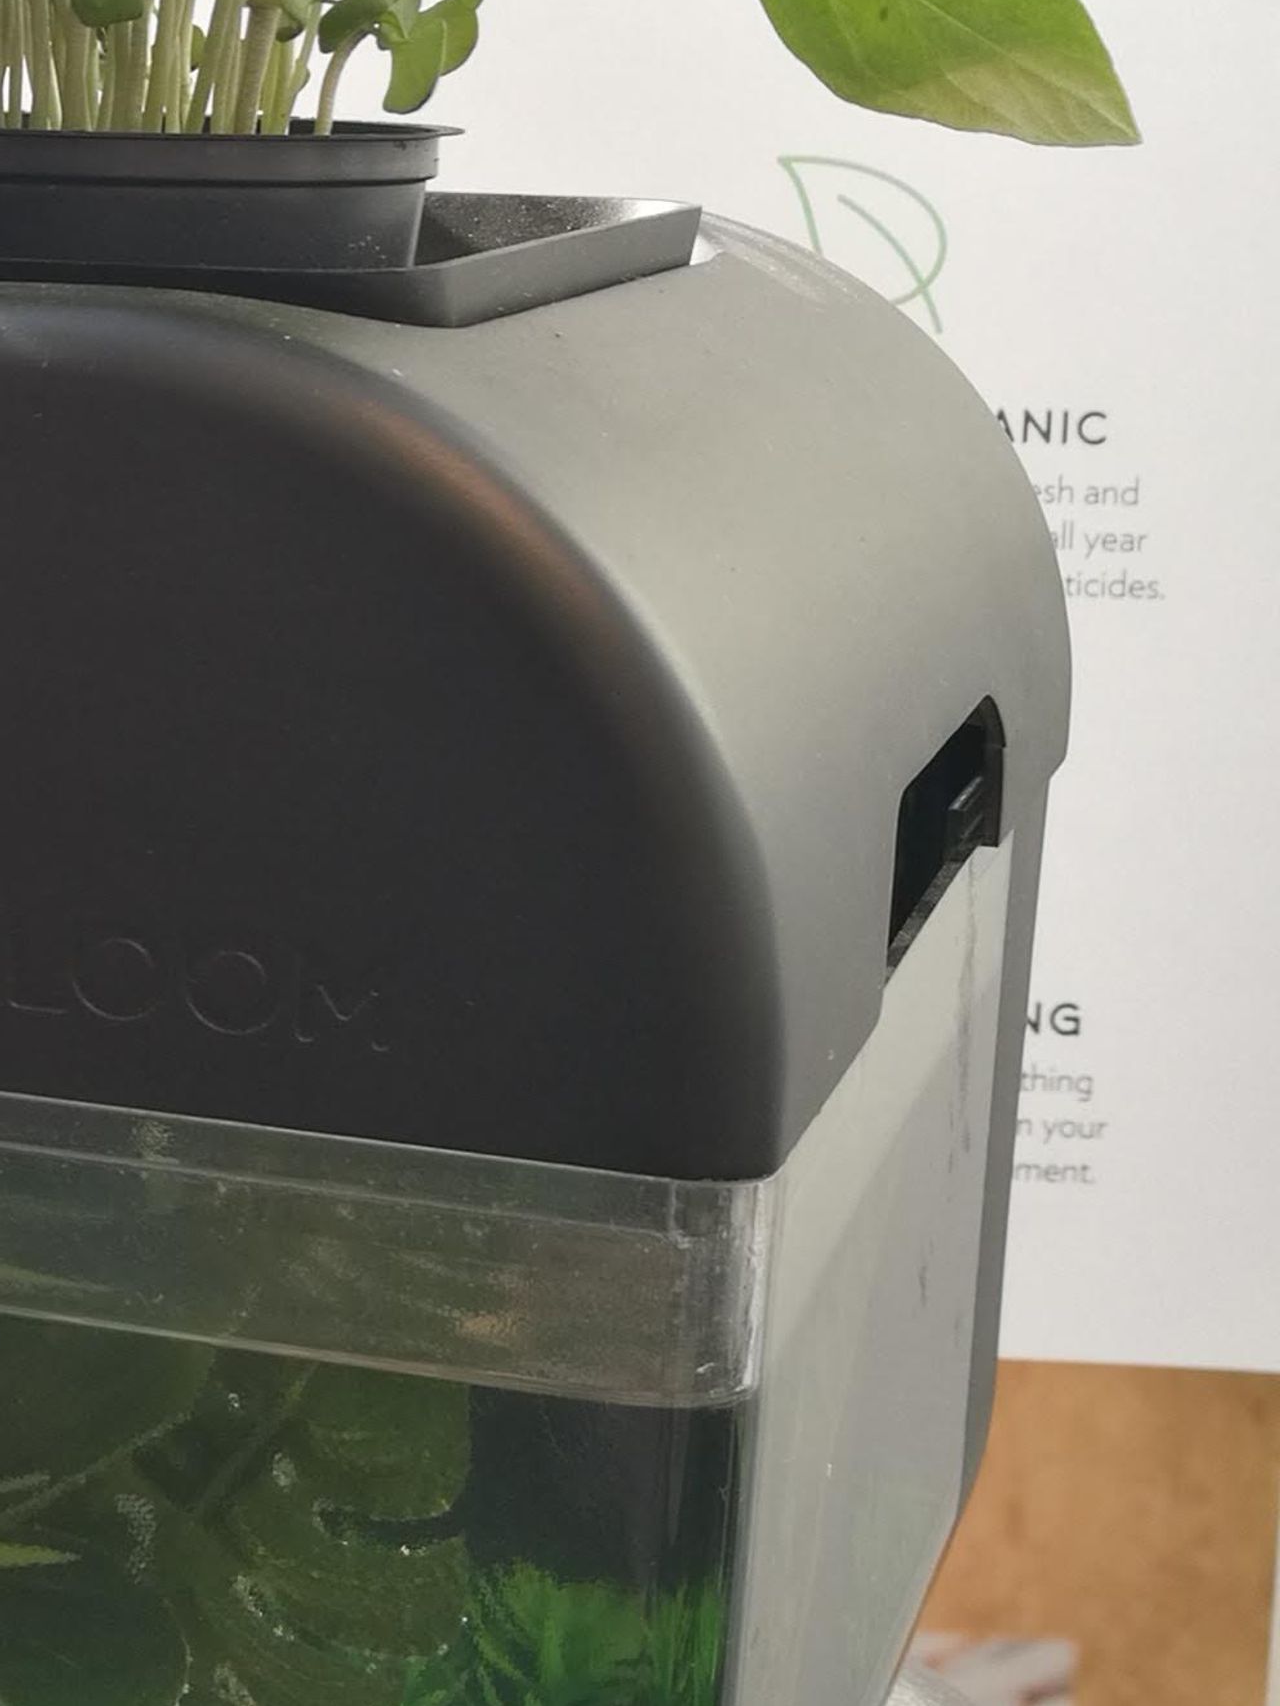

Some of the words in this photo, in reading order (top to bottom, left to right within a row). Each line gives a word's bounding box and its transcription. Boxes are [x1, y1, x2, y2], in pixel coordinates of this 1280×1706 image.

[1084, 475, 1141, 506] and
[1084, 533, 1148, 560] year
[1042, 1119, 1109, 1146] your
